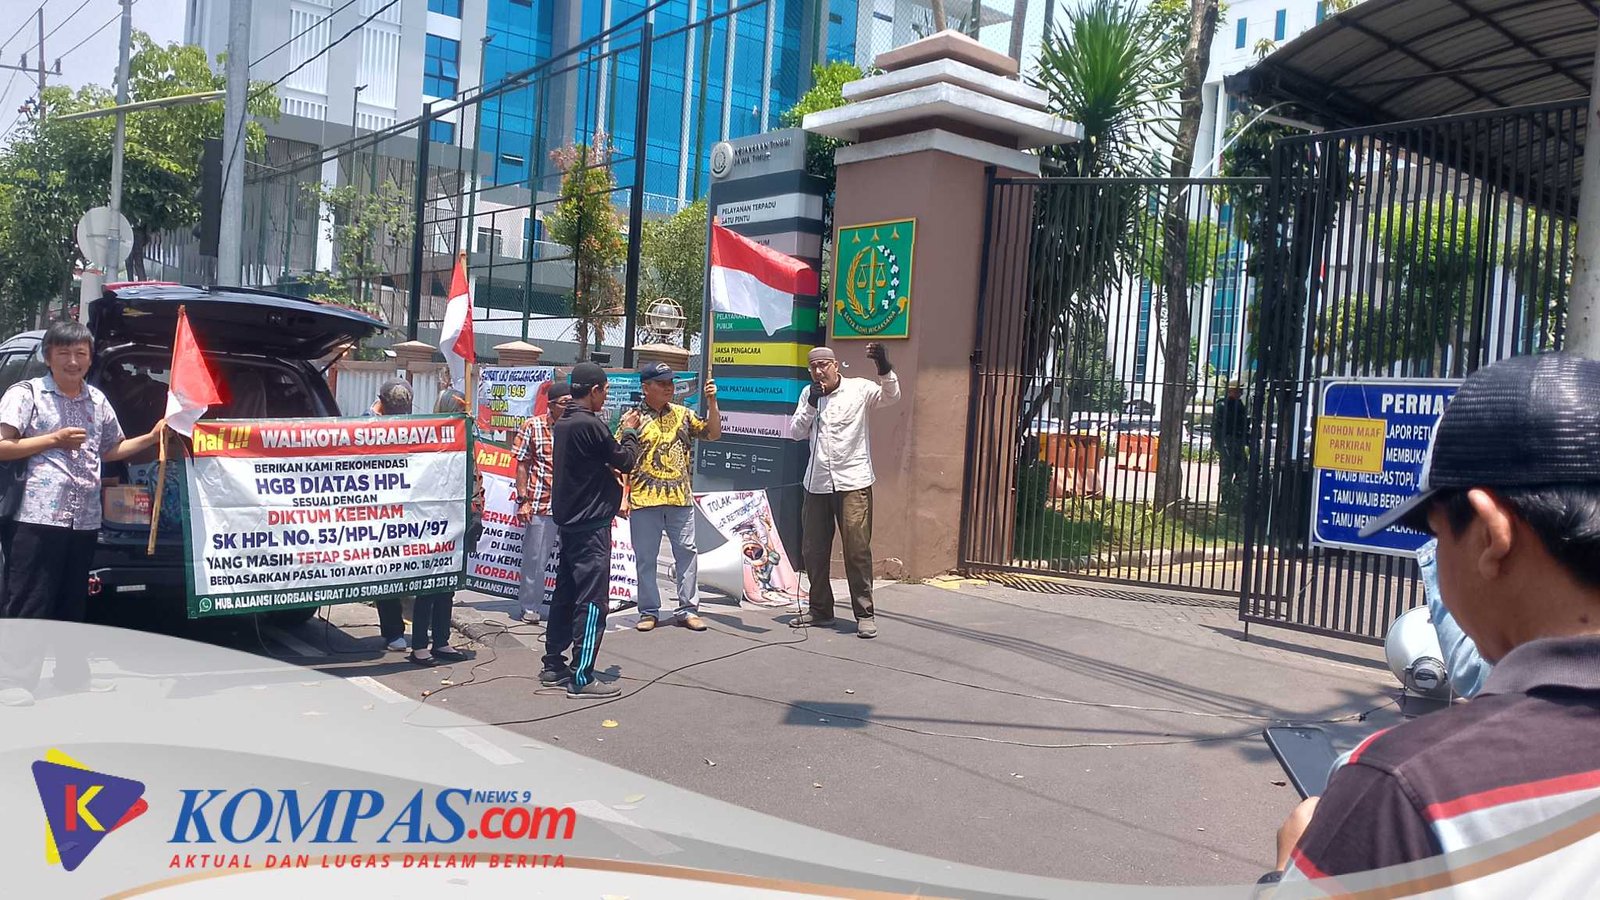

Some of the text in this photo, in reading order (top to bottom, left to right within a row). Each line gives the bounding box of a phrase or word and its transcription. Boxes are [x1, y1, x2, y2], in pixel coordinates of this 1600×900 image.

[721, 201, 776, 215] PELAYANAN TERPADU
[734, 215, 750, 224] PINTU
[507, 384, 526, 398] 1945
[1381, 393, 1455, 415] PERHA
[731, 426, 757, 434] TAHANAN
[1323, 424, 1382, 439] MOHON MAAF
[1413, 425, 1431, 441] PETU
[193, 425, 456, 453] hai !!! WALIKOTA SURABAYA !!!
[1329, 439, 1372, 453] PARKIRAN
[254, 459, 409, 474] BERIKAN KAMI REKOMENDASI
[476, 449, 512, 468] hai !!!
[1334, 453, 1364, 466] PENUH
[255, 472, 411, 495] HGB DIATAS HPL
[1334, 469, 1357, 482] WAJIB
[1358, 470, 1394, 485] MELEPAS
[1395, 471, 1415, 491] TOPI,
[292, 494, 378, 507] SESUAI DENGAN
[707, 495, 732, 513] TOLAK
[1333, 489, 1355, 505] TAMU
[1355, 491, 1379, 507] WAJIB
[268, 504, 404, 526] DIKTUM KEENAM
[1331, 512, 1354, 528] TAMU
[212, 520, 449, 550] SK HPL NO. 53/HPL/BPN/'97
[206, 540, 456, 570] YANG MASIH TETAP SAH DAN BERLAKU
[469, 551, 480, 560] UK
[482, 553, 497, 563] ITU
[490, 541, 626, 571] DI LING AYA
[611, 553, 625, 561] SIP
[210, 557, 453, 586] BERDASARKAN PASAL 101 AYAT (1) PP NO. 18/2021
[473, 580, 503, 593] ALIANSI
[503, 586, 520, 596] KOR
[474, 563, 632, 599] KORBAN ARA
[214, 597, 234, 610] HUB.
[234, 594, 273, 609] ALIANSI
[274, 591, 313, 605] KORBAN
[314, 588, 345, 602] SURAT
[345, 587, 360, 599] IJO
[361, 583, 404, 597] SURABAYA
[409, 580, 422, 591] 081
[422, 579, 436, 590] 231
[436, 577, 449, 588] 231
[449, 575, 458, 586] 99
